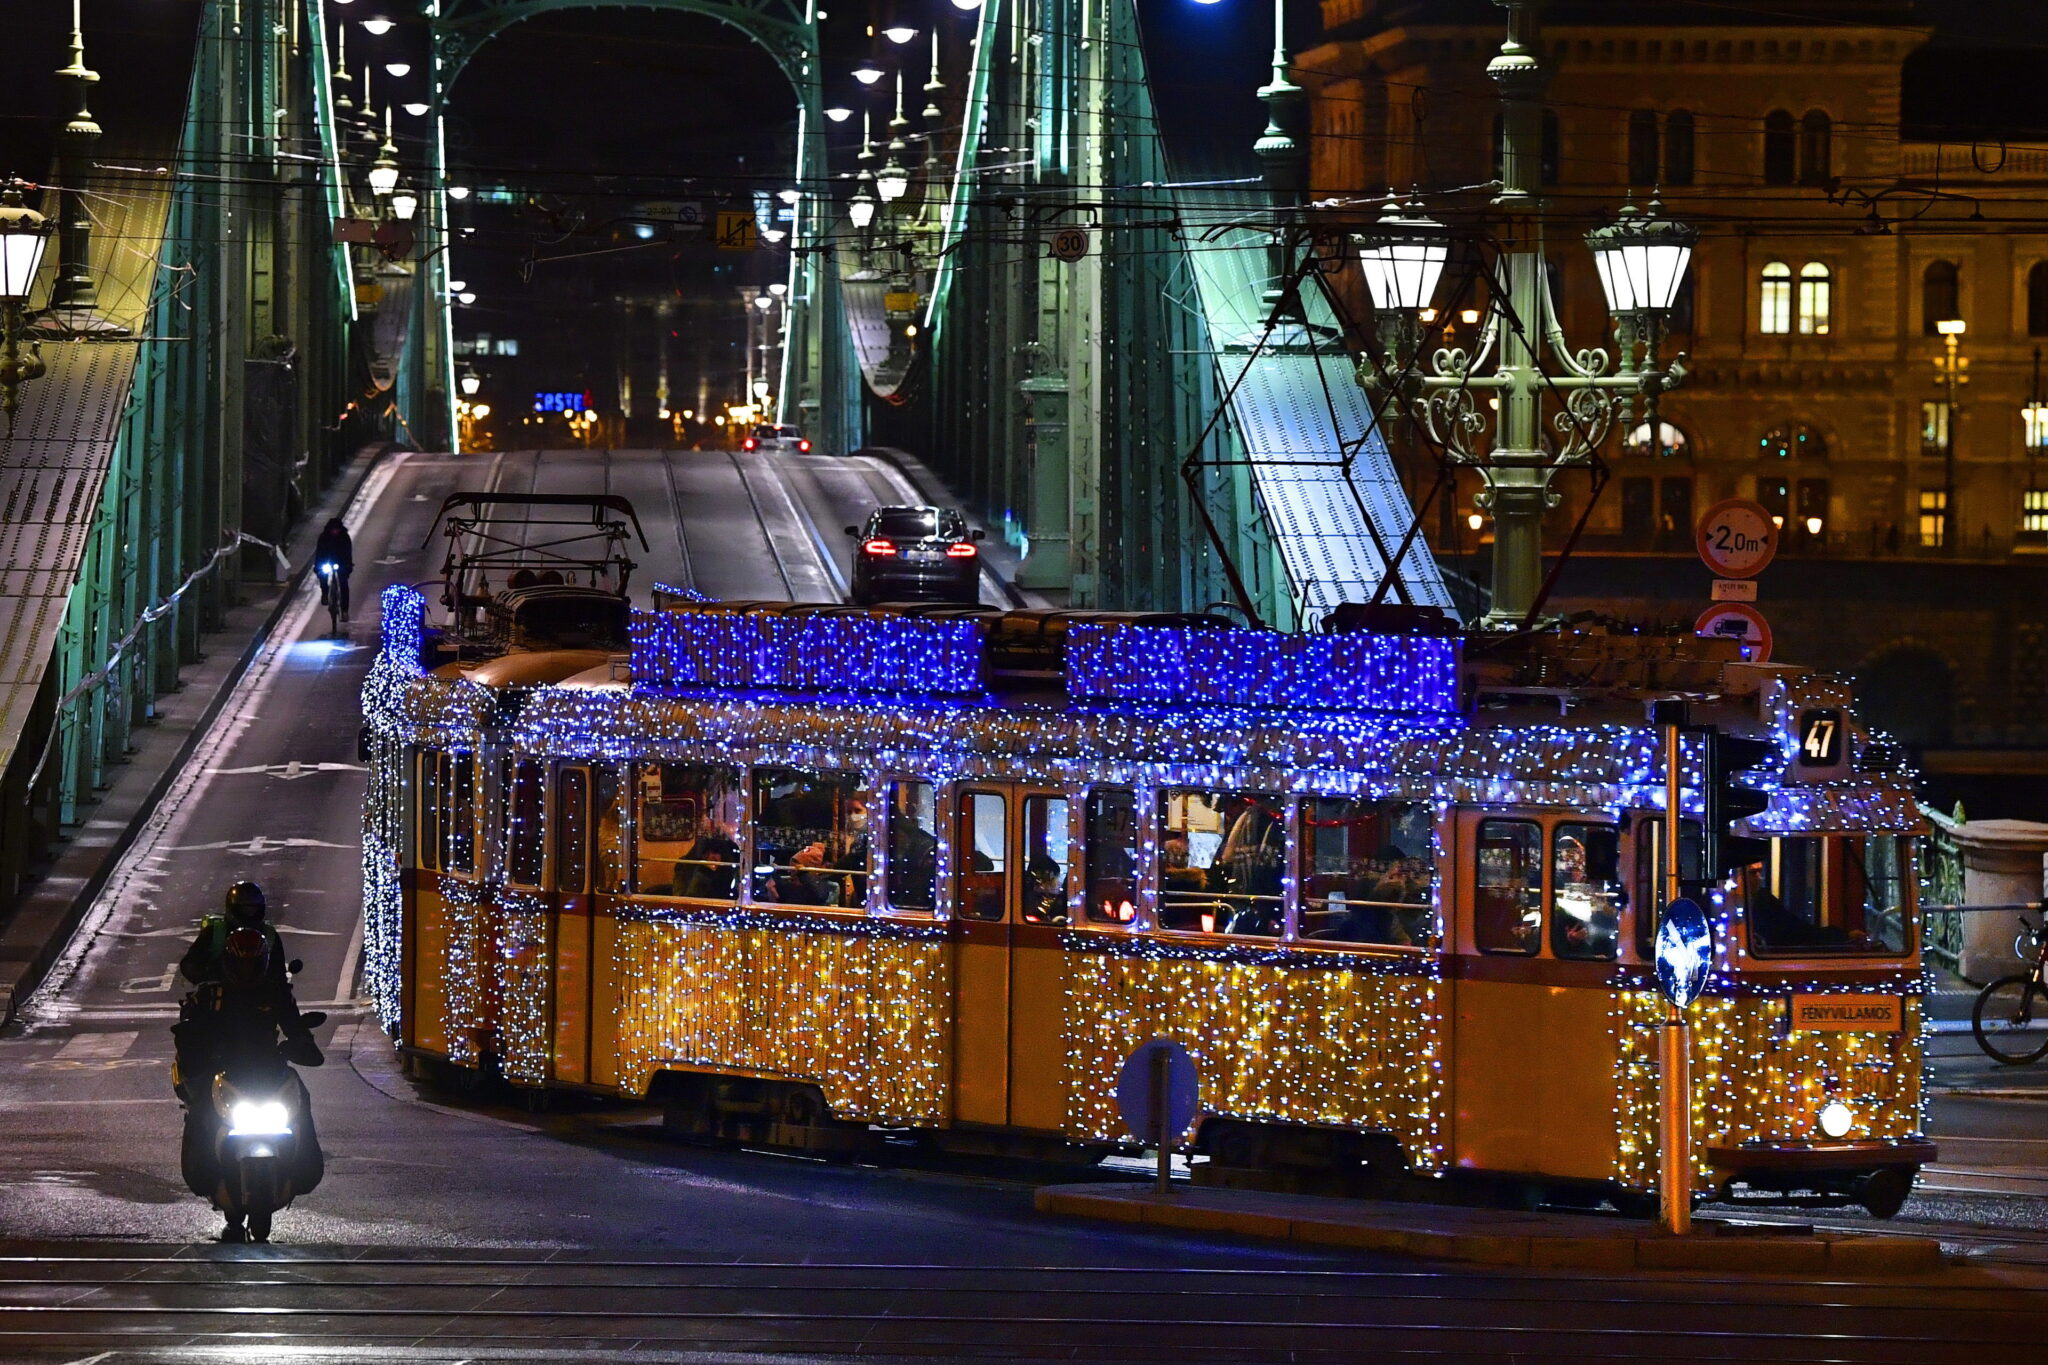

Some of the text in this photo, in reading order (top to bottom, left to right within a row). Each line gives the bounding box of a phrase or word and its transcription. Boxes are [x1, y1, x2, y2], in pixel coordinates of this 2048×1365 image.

[1060, 235, 1081, 251] 30
[1715, 525, 1759, 553] 2,0m
[1804, 720, 1835, 758] 47
